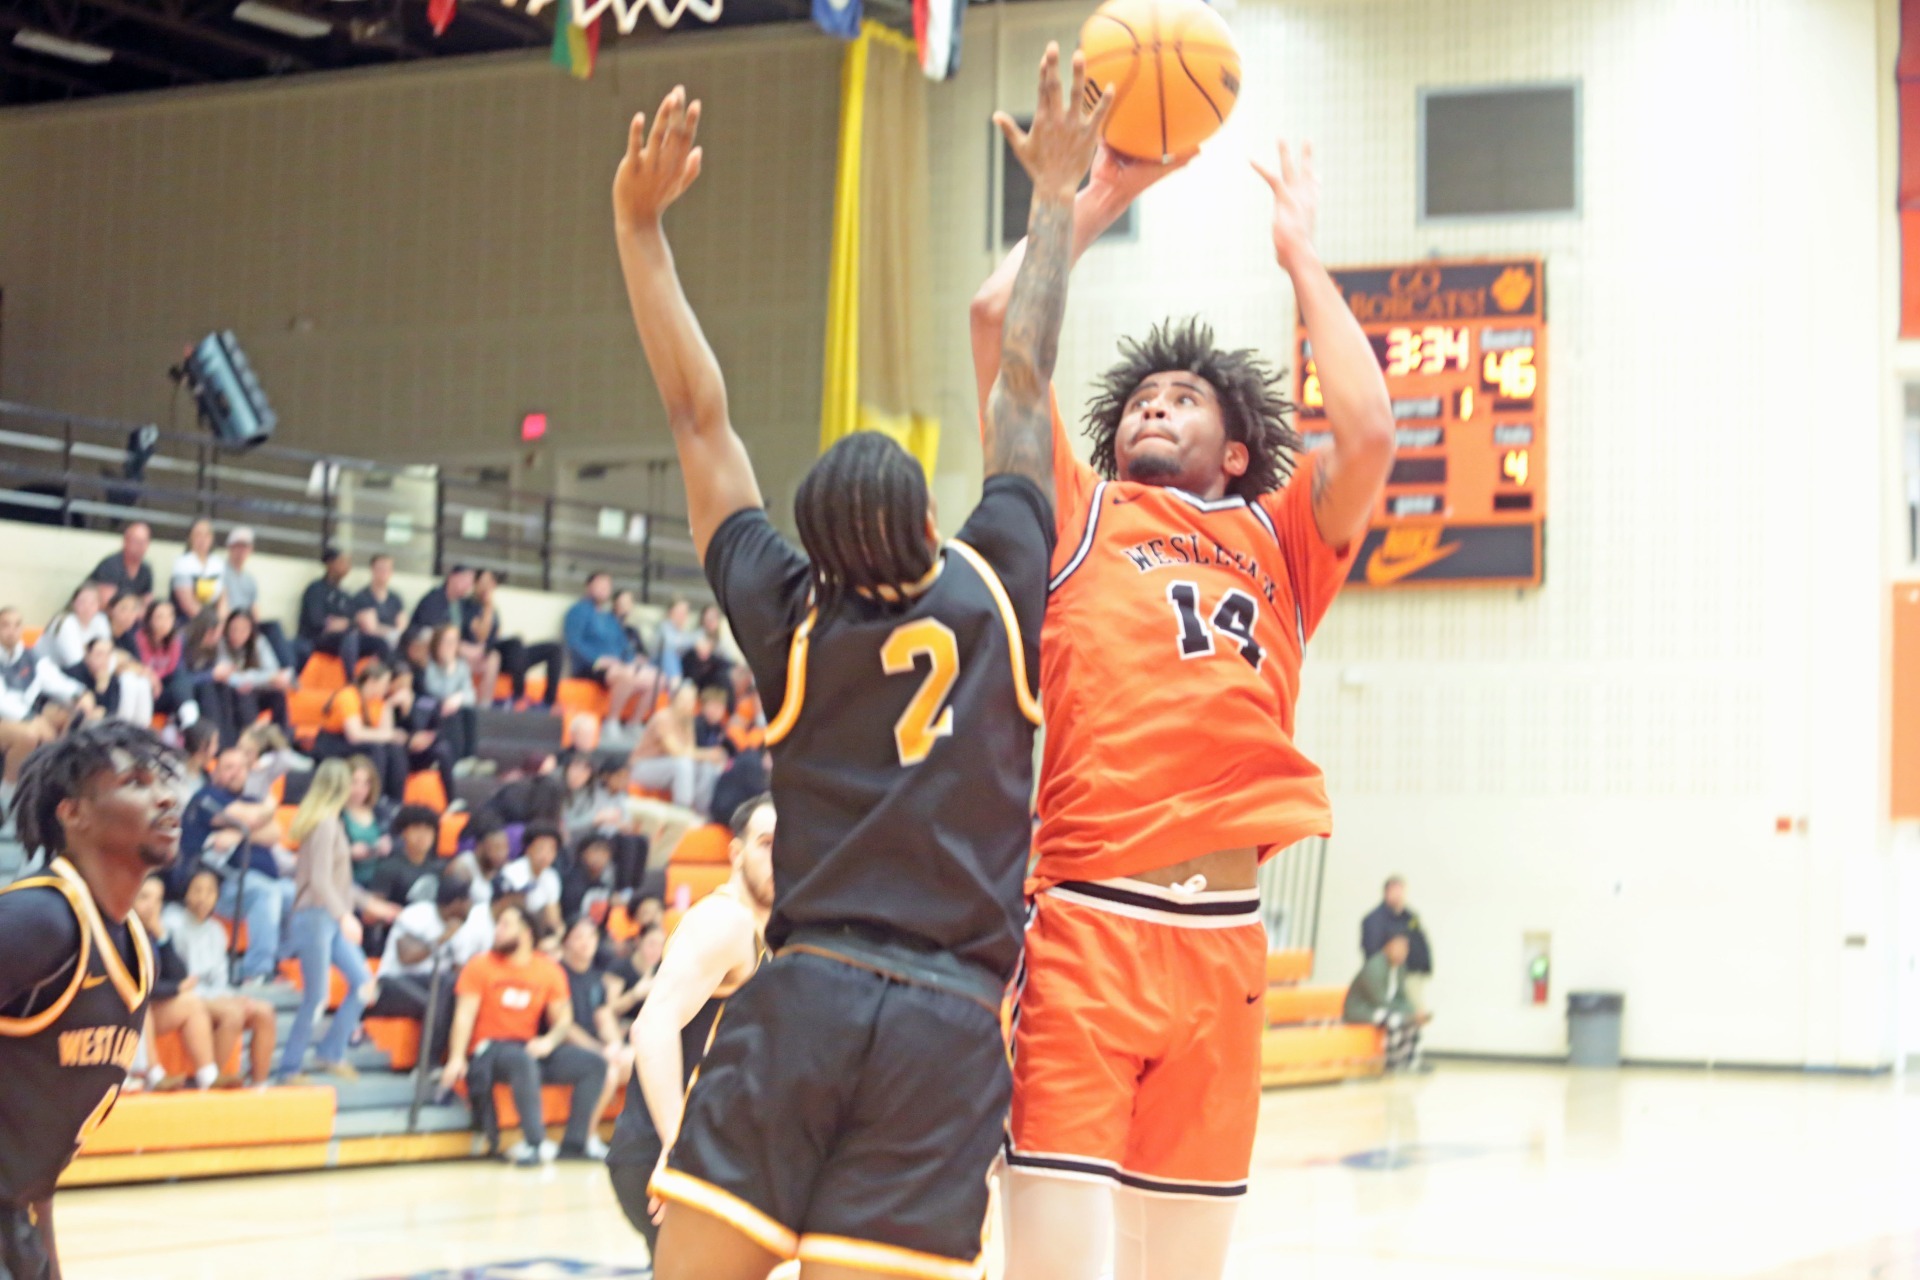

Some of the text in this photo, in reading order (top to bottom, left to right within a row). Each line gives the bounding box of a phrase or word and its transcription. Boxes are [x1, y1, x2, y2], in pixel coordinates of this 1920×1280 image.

[1387, 326, 1469, 376] 3:34
[1484, 347, 1536, 398] 46
[1504, 449, 1528, 486] 4
[1166, 579, 1267, 674] 14
[880, 615, 960, 767] 2
[58, 1025, 118, 1067] WEST
